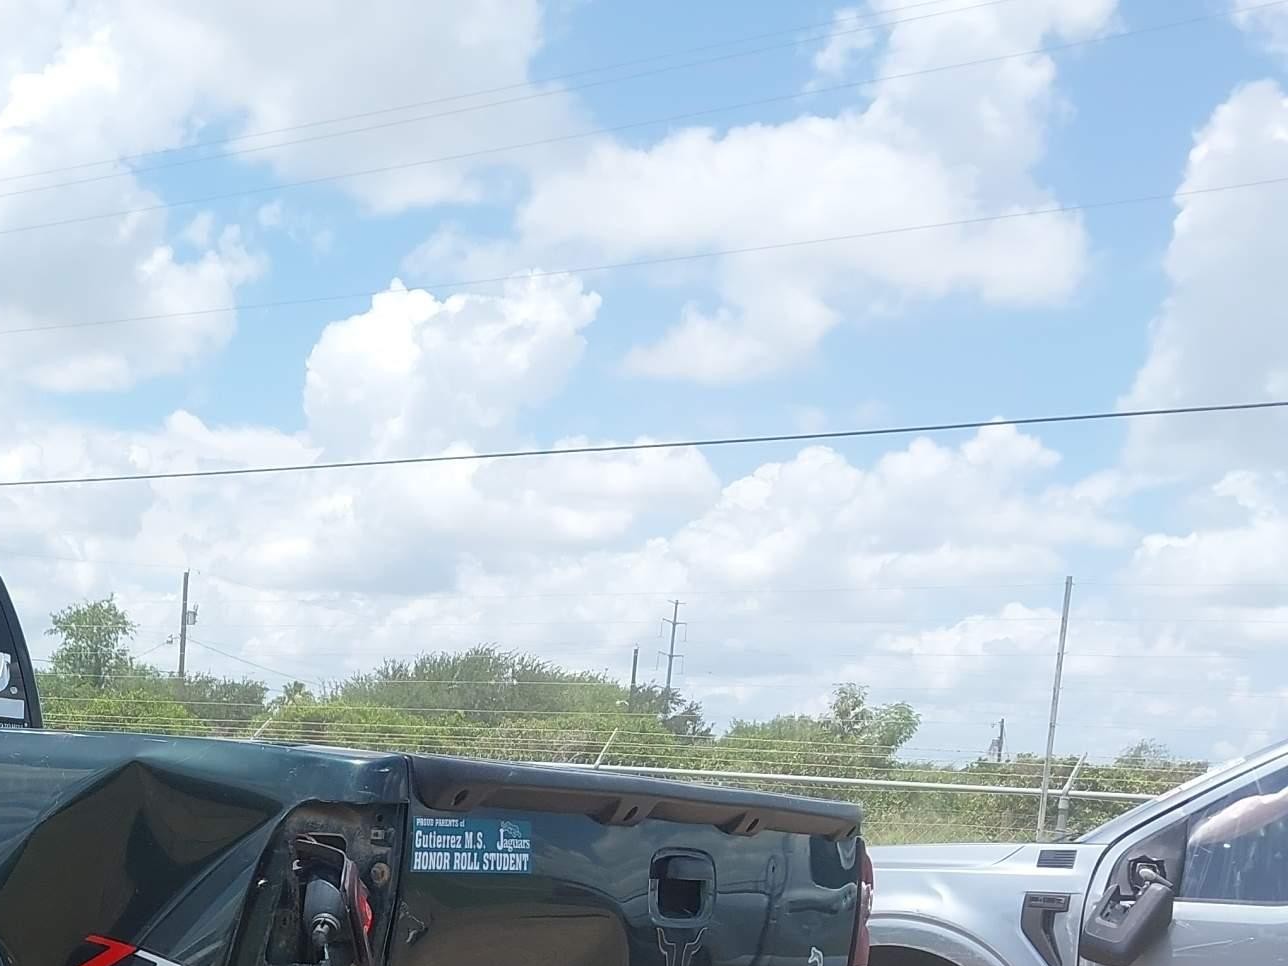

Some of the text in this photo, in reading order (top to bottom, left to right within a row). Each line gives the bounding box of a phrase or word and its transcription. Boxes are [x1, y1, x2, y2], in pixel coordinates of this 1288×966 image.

[416, 818, 434, 827] PROUD
[435, 818, 459, 828] PARENTS
[415, 830, 486, 849] Gutierrez M.S.
[496, 828, 531, 852] Jaguars
[413, 851, 529, 871] HONOR ROLL STUDENT
